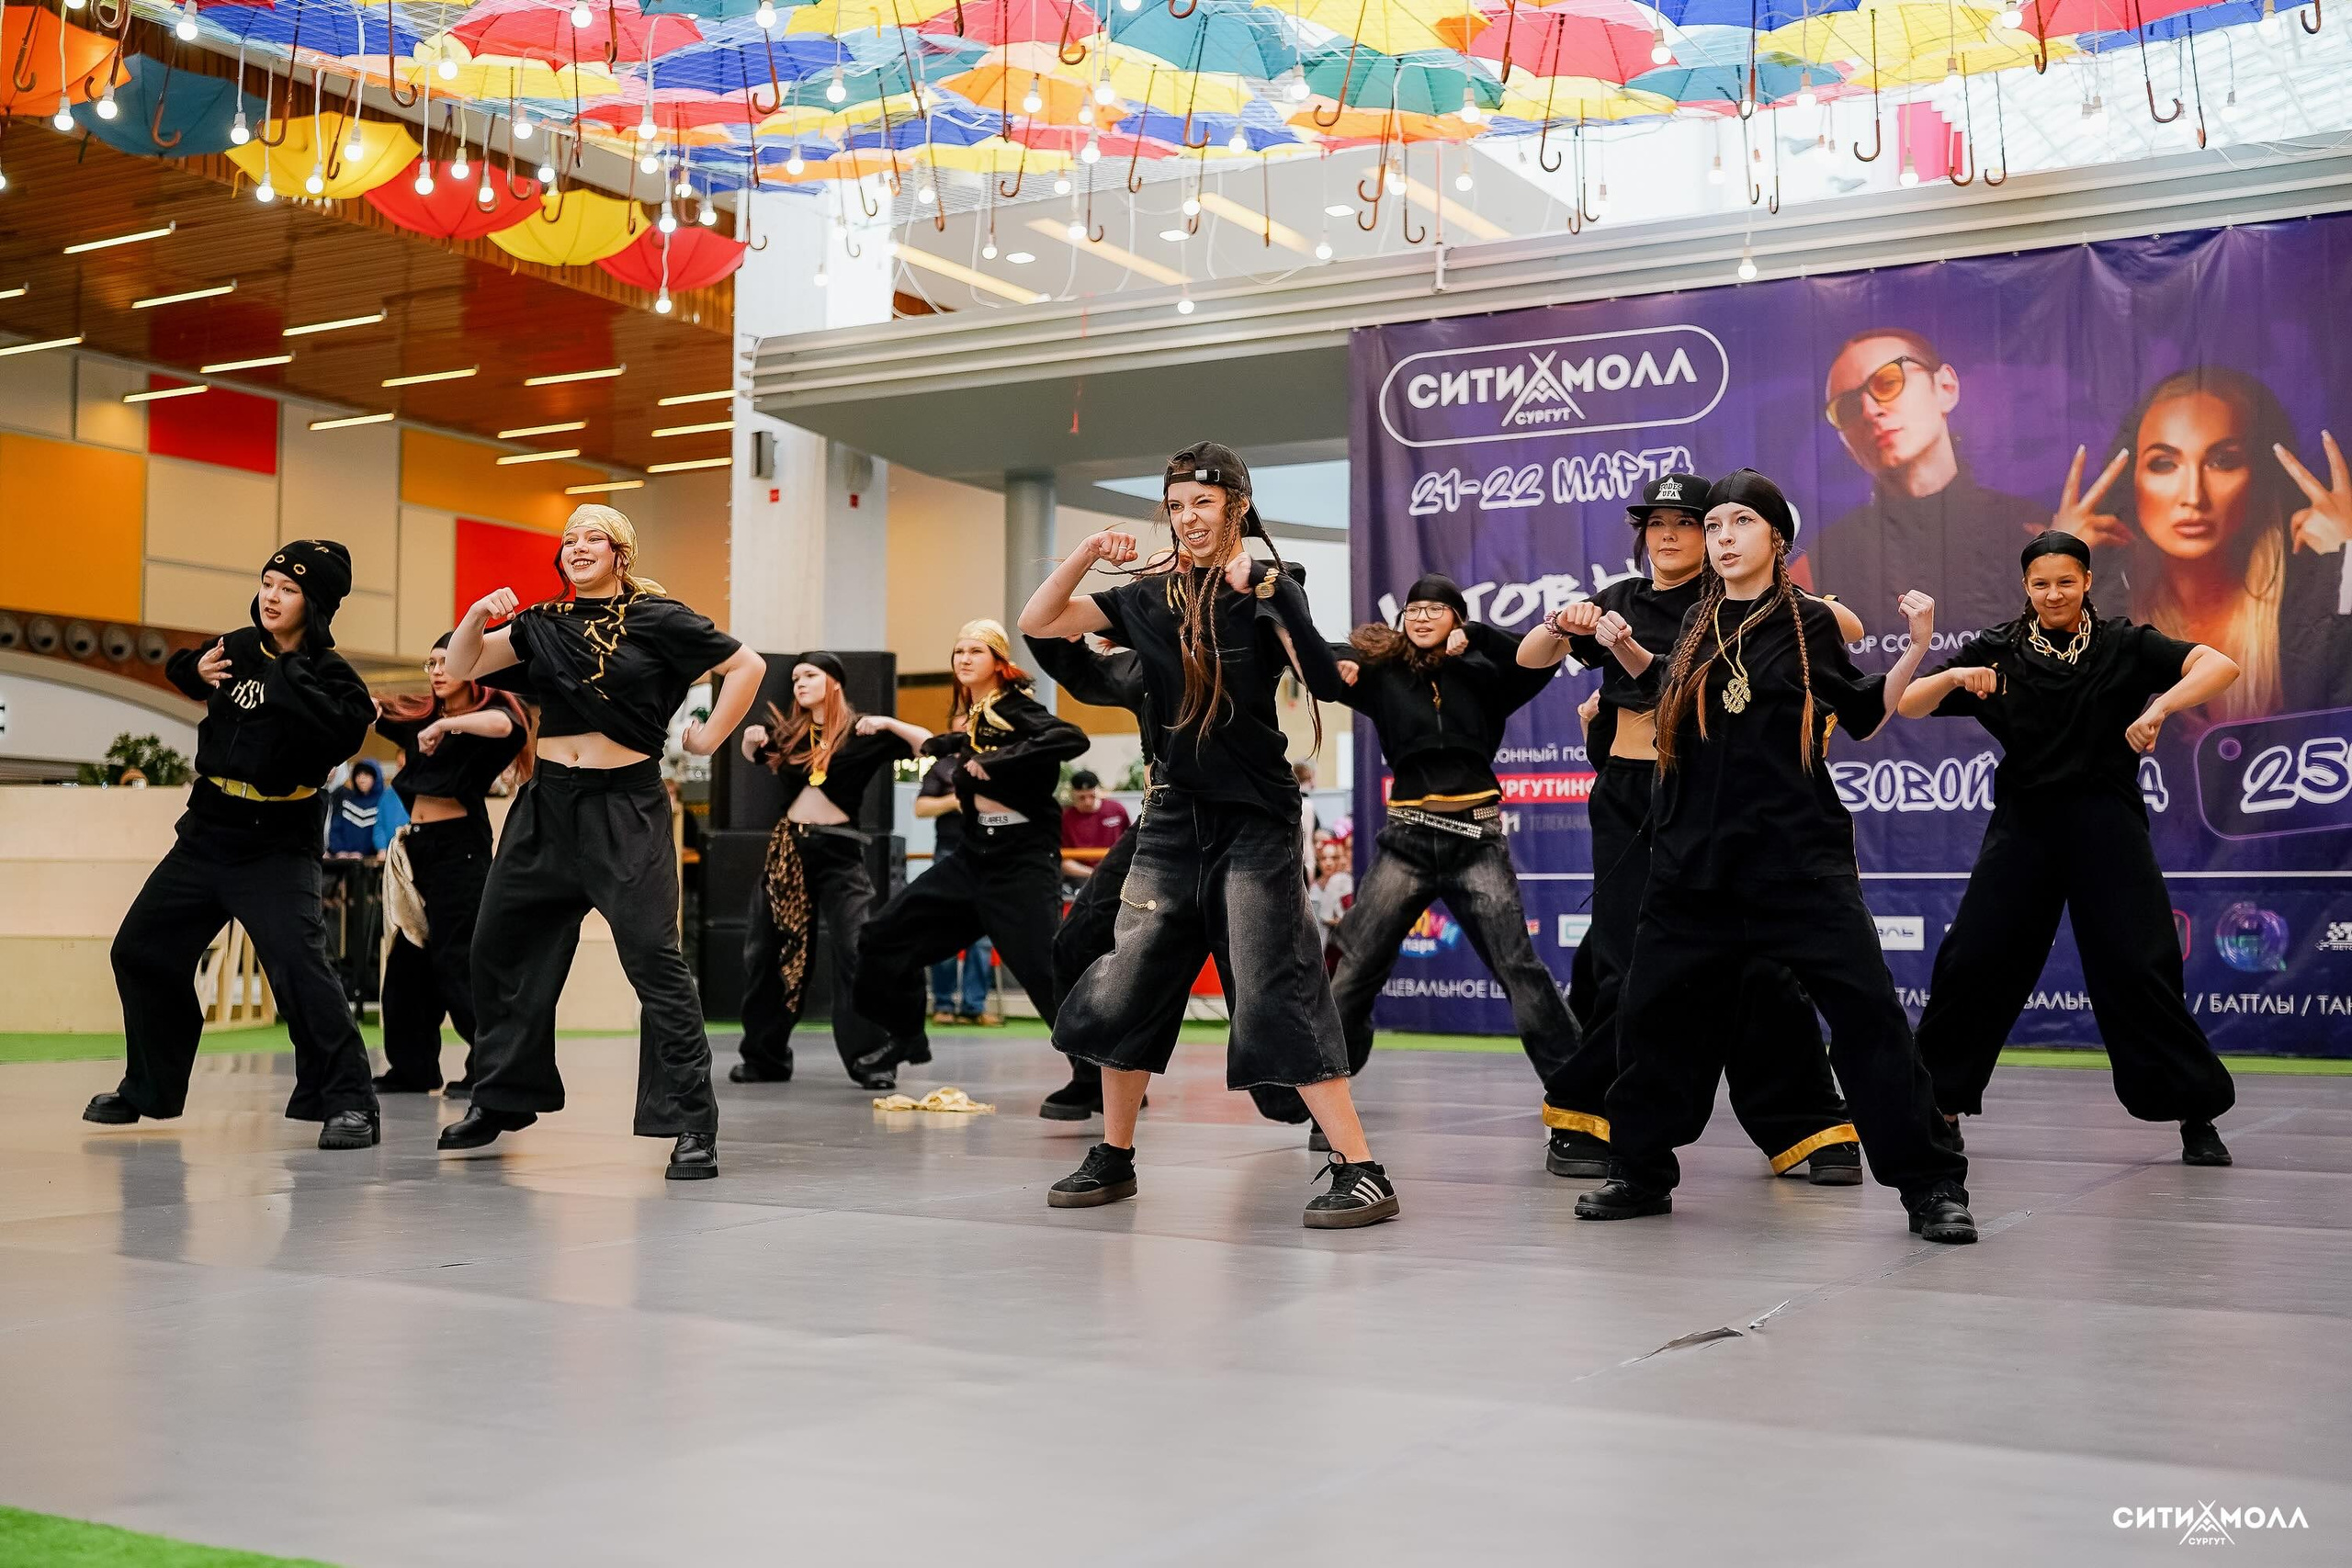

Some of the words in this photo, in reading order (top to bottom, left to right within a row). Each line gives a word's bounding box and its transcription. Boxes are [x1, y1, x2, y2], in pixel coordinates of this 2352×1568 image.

[1407, 364, 1526, 410] СИТИ
[1561, 347, 1698, 393] МОЛЛ
[1514, 407, 1572, 425] СУРГУТ
[1408, 464, 1545, 516] 21-22
[1552, 446, 1696, 504] МАРТА
[1882, 630, 1982, 653] СООЛО
[1826, 751, 1996, 812] ЗОВОЙ
[2240, 737, 2352, 814] 25
[1381, 977, 1488, 999] ЦЕВАЛЬНОЕ
